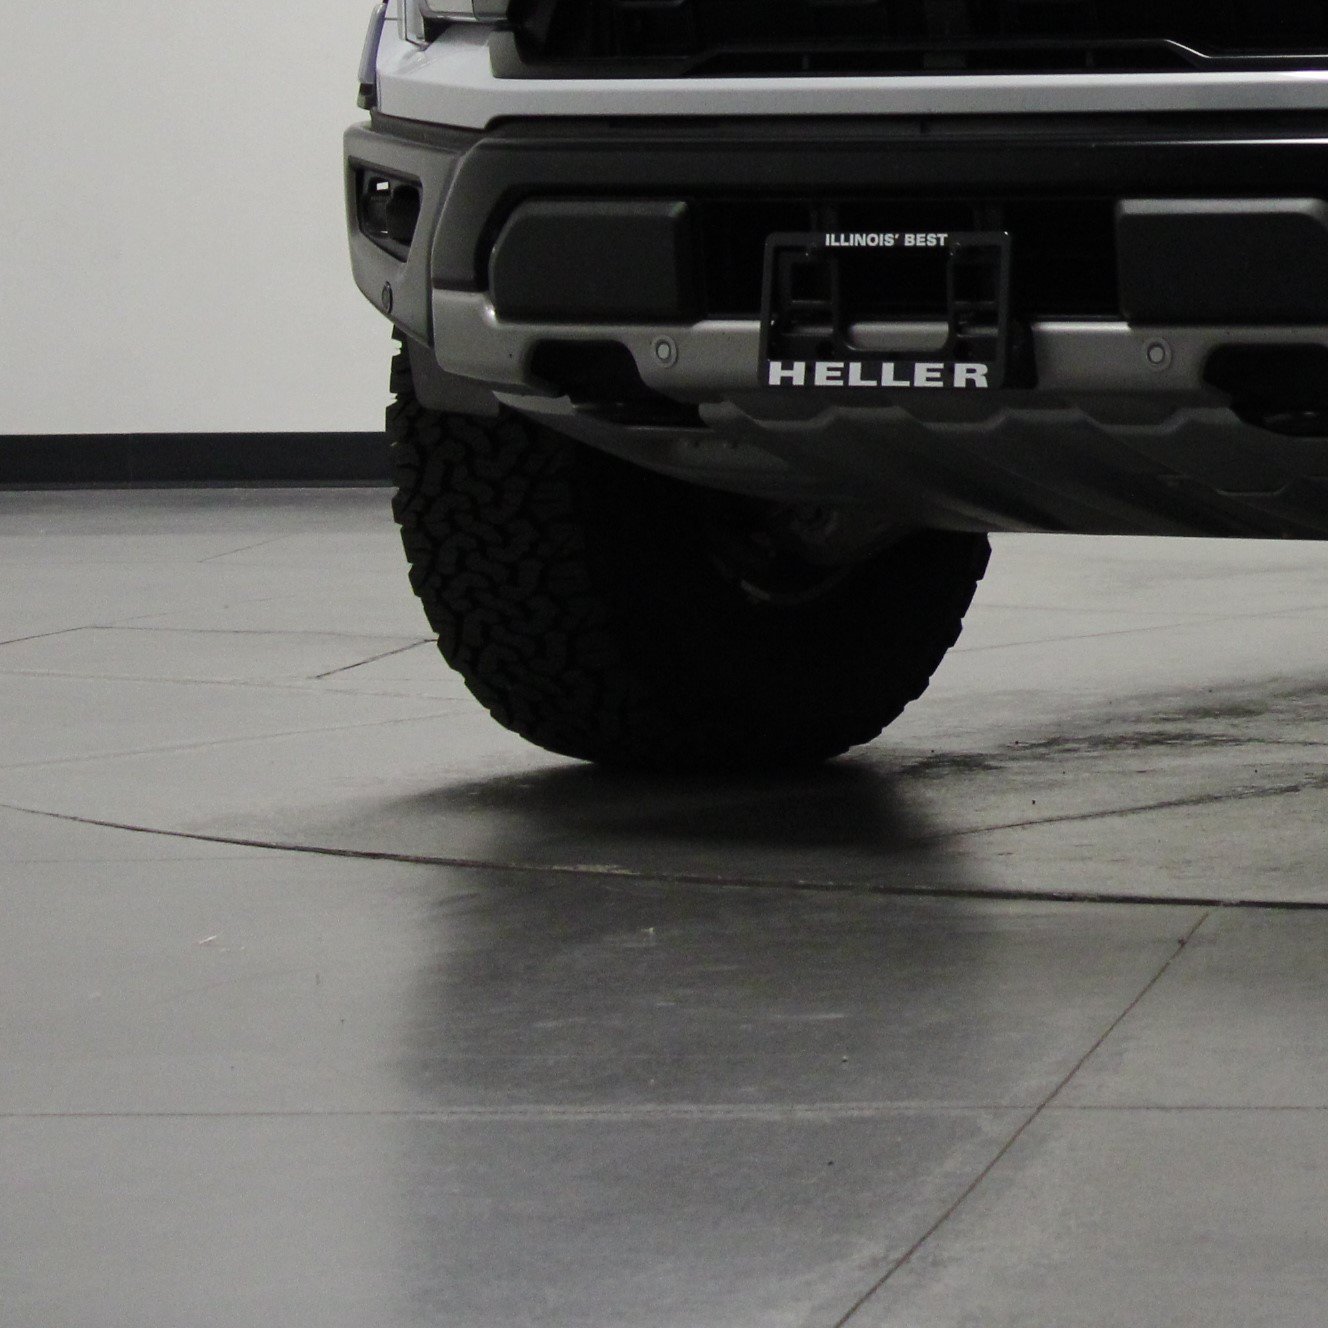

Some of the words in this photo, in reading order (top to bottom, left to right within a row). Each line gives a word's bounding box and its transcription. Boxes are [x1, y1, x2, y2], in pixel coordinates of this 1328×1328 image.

[824, 233, 900, 247] ILLINOIS'
[903, 232, 949, 247] BEST
[767, 360, 989, 389] HELLER
